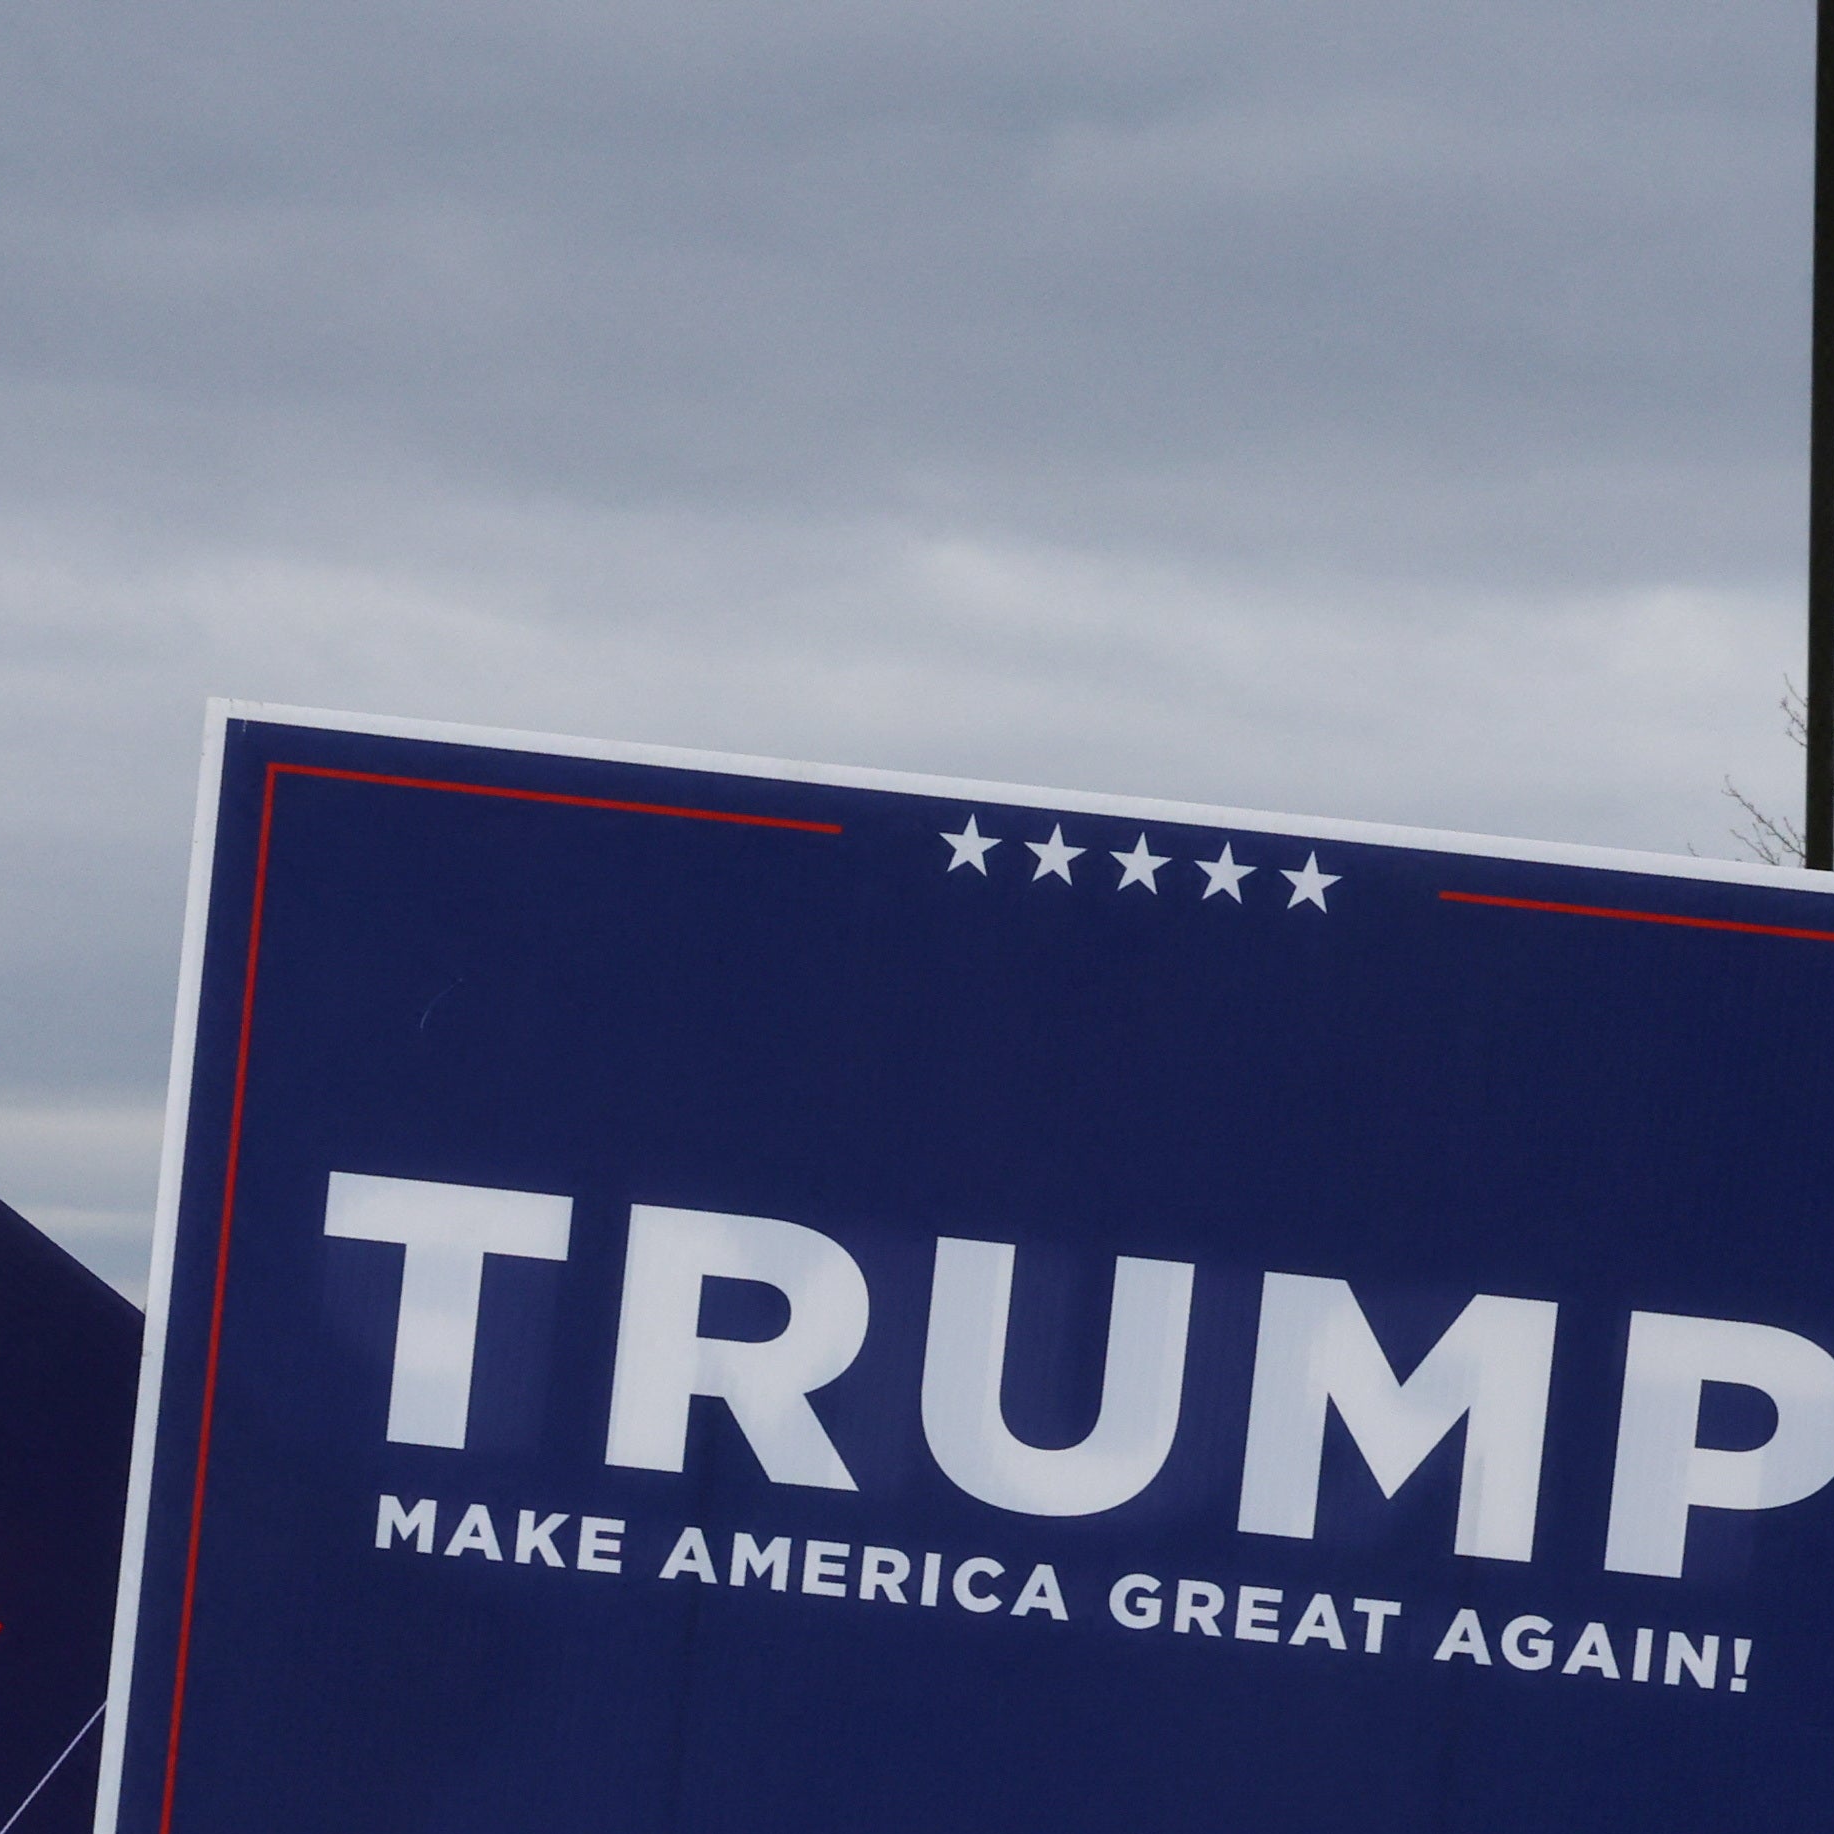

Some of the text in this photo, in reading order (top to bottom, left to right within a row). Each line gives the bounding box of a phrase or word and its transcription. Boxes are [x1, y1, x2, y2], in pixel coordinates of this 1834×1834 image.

[376, 1495, 1751, 1692] MAKE AMERICA GREAT AGAIN!
